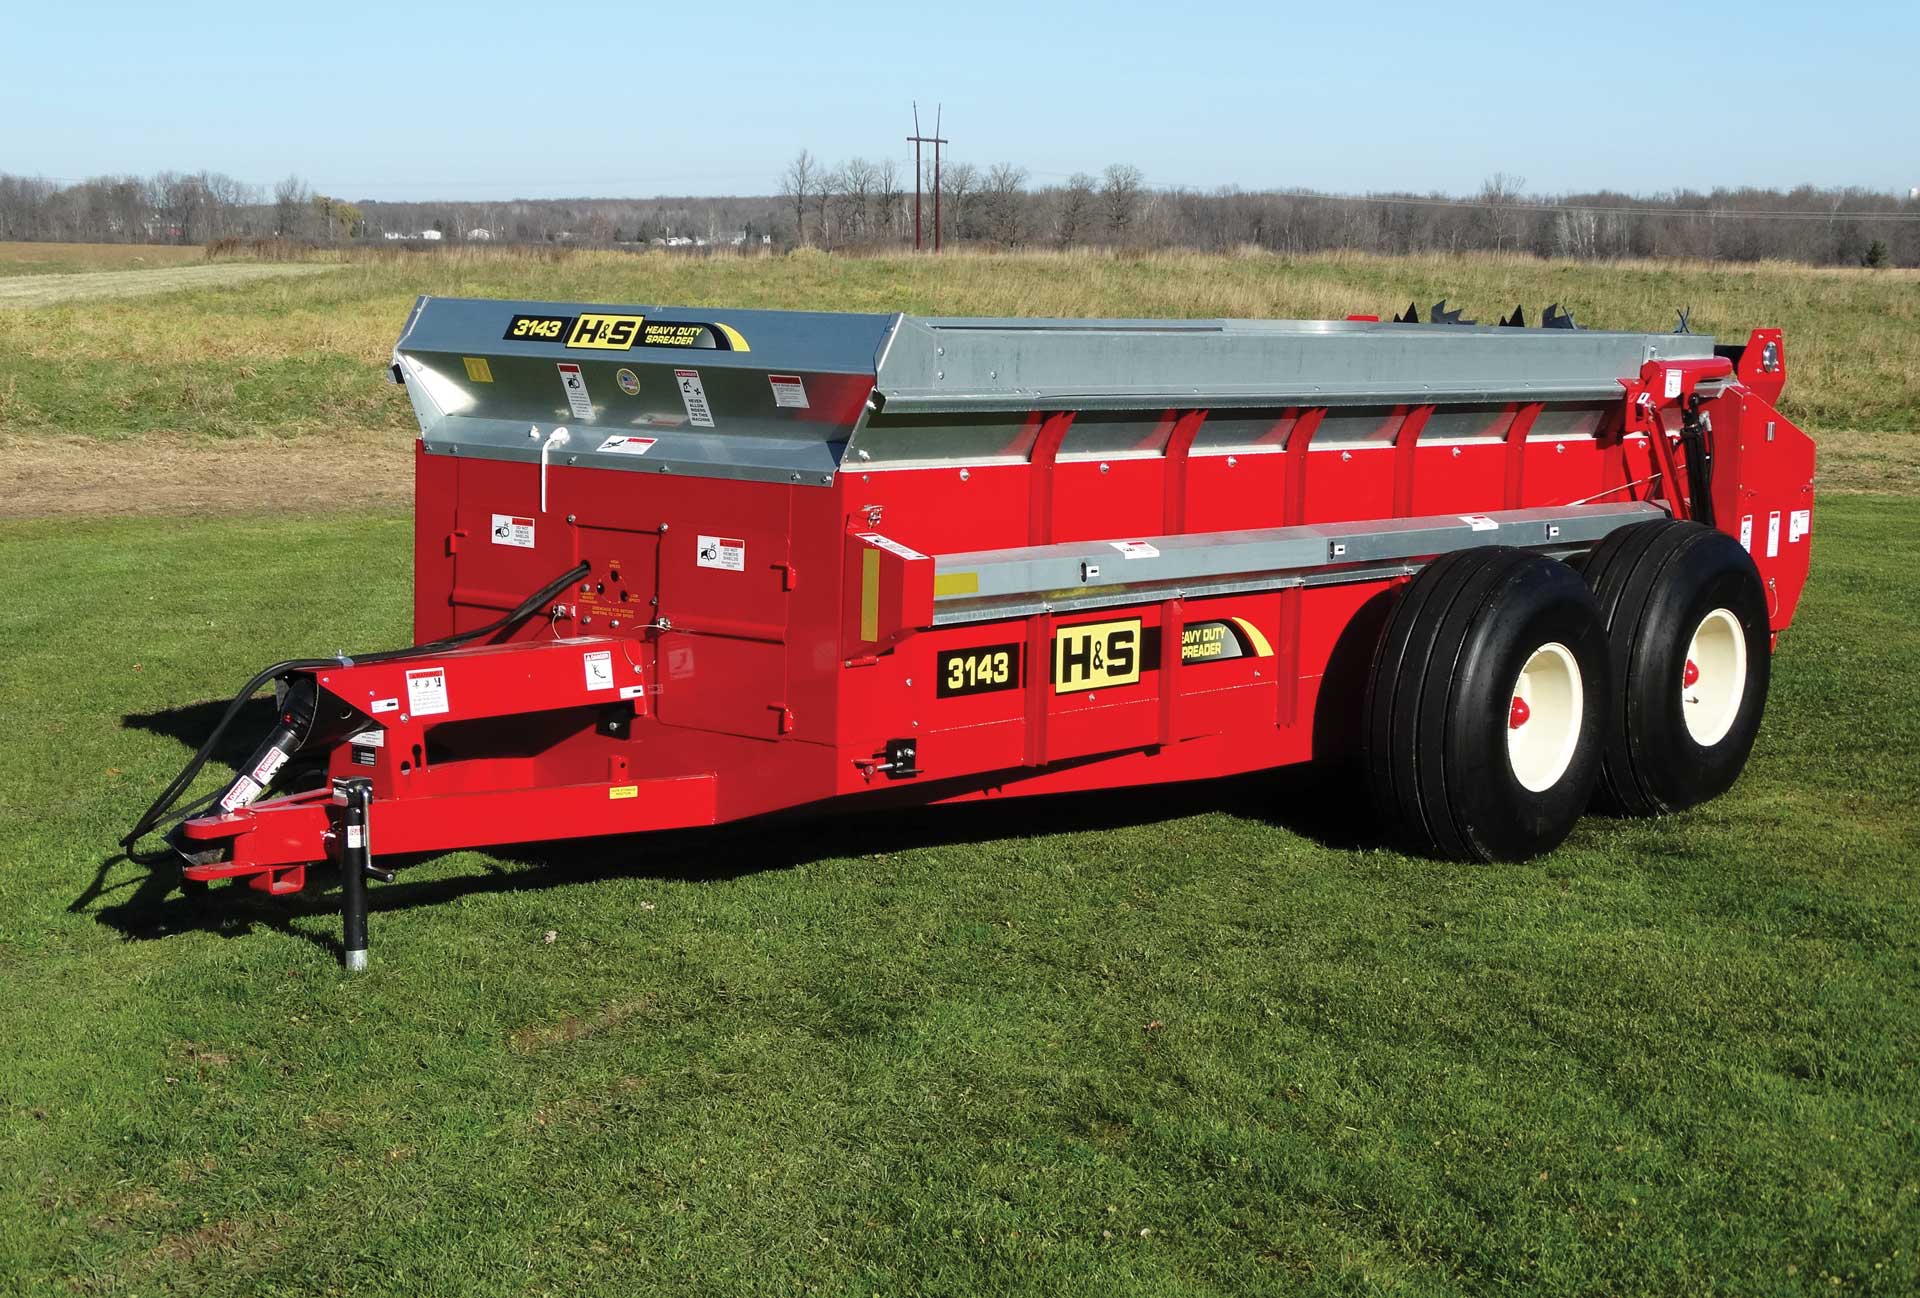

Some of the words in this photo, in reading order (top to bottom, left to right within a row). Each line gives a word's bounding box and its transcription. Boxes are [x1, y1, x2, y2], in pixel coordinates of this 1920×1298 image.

[513, 319, 562, 337] 3143
[574, 319, 637, 345] H&S
[645, 325, 677, 336] HEAVY
[678, 326, 703, 337] DUTY
[645, 334, 694, 345] SPREADER
[1203, 626, 1226, 642] DUTY
[1061, 629, 1135, 684] H&S
[1182, 642, 1222, 659] PREADER
[947, 652, 1009, 690] 3143
[262, 749, 281, 772] DANGER
[229, 778, 251, 801] DANGER
